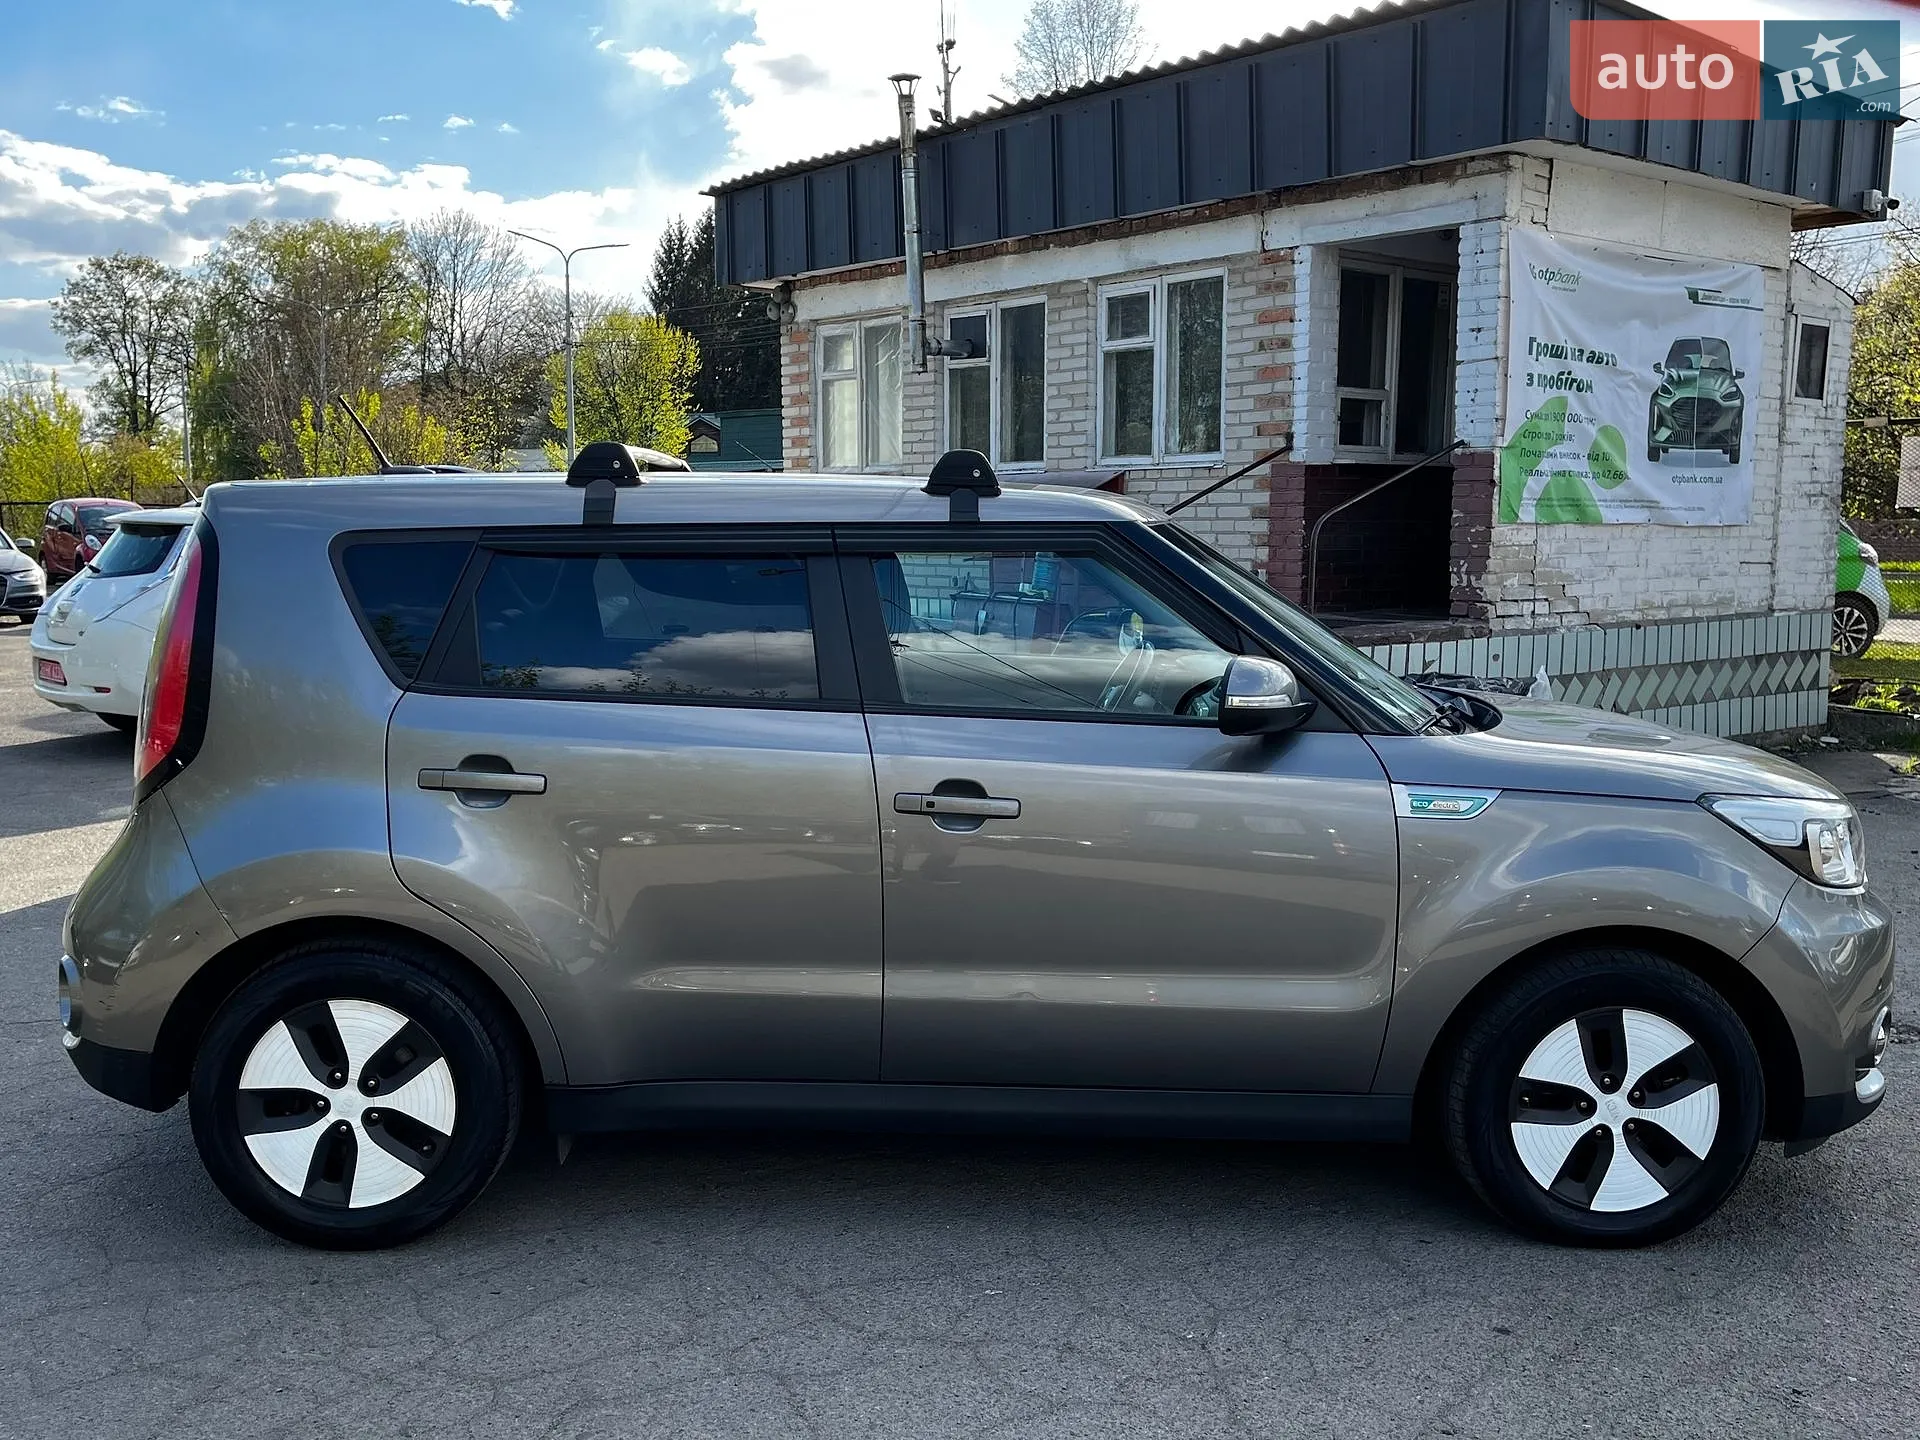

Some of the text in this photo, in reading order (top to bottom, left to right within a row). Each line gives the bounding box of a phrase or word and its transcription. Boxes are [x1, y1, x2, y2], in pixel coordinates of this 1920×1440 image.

[1528, 336, 1618, 367] Гроші на авто
[1526, 370, 1593, 393] з пробігом
[1587, 450, 1599, 462] від
[1671, 474, 1723, 486] otpbank.com.ua
[1412, 800, 1458, 809] eco electric
